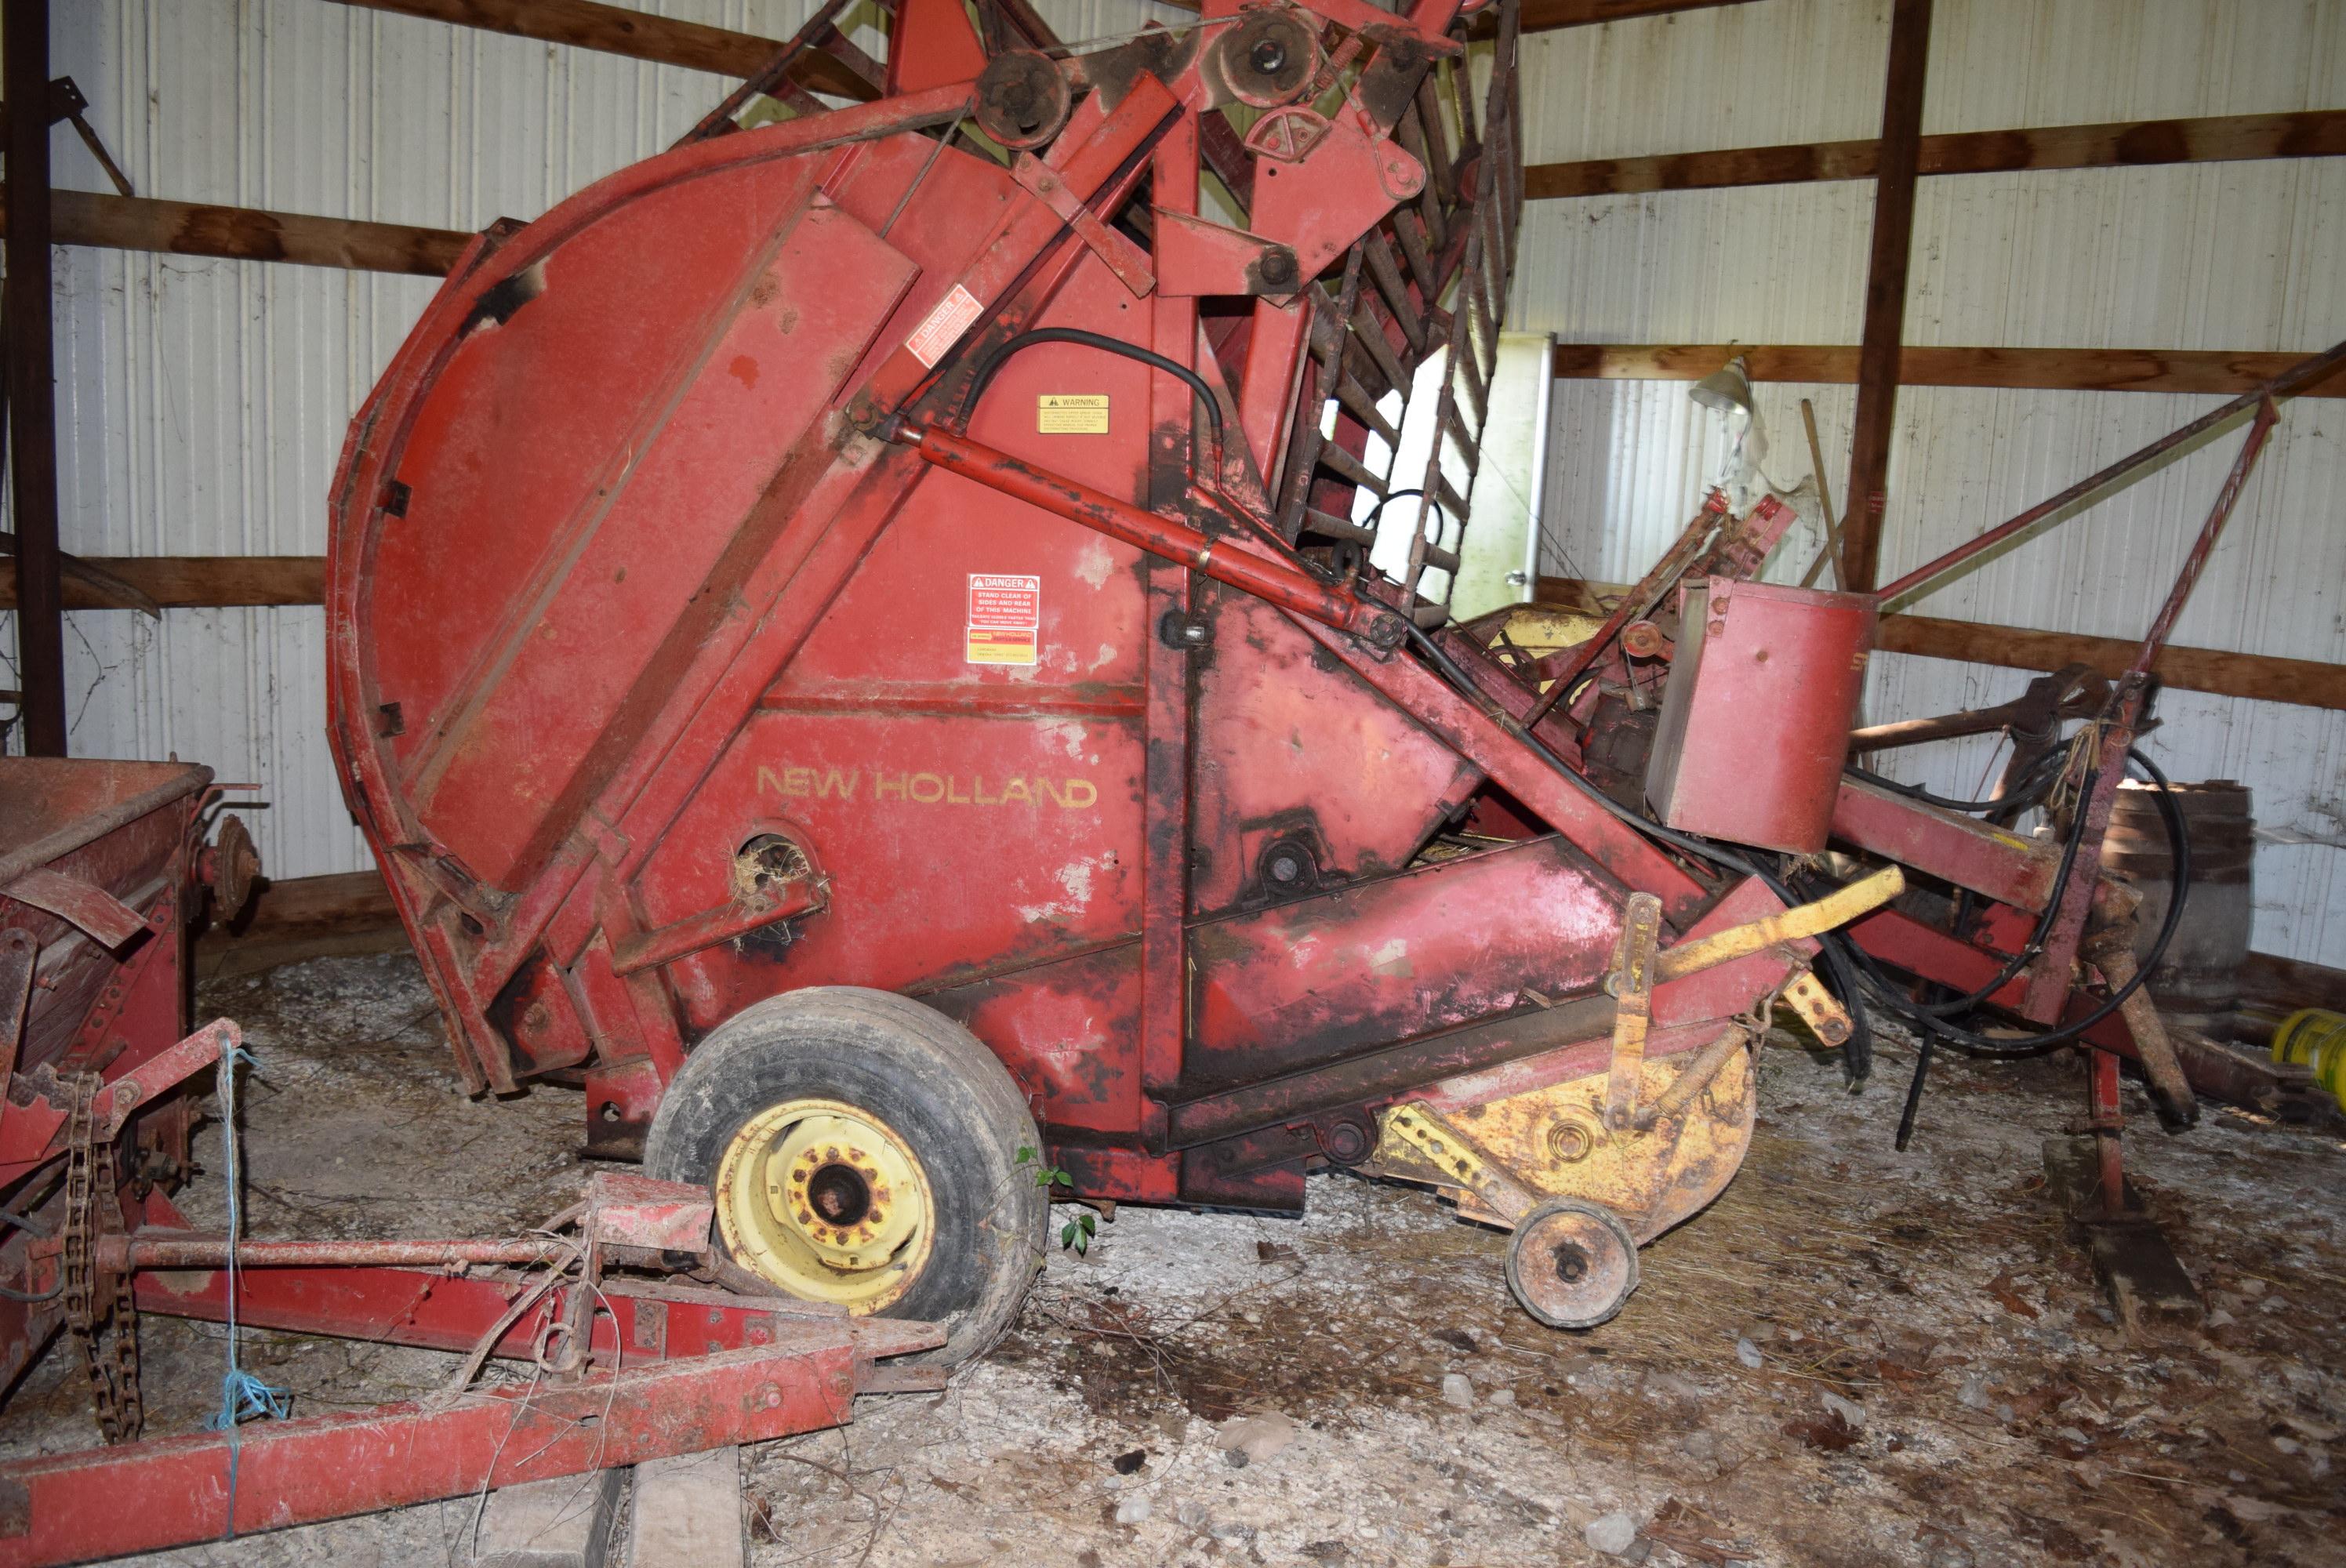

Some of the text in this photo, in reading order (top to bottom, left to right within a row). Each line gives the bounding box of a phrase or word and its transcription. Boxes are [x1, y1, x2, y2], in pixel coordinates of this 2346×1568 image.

[921, 302, 954, 338] DANGER
[1062, 398, 1099, 407] WARNING
[985, 578, 1023, 588] DANGER
[757, 765, 1099, 811] NEW HOLLAND
